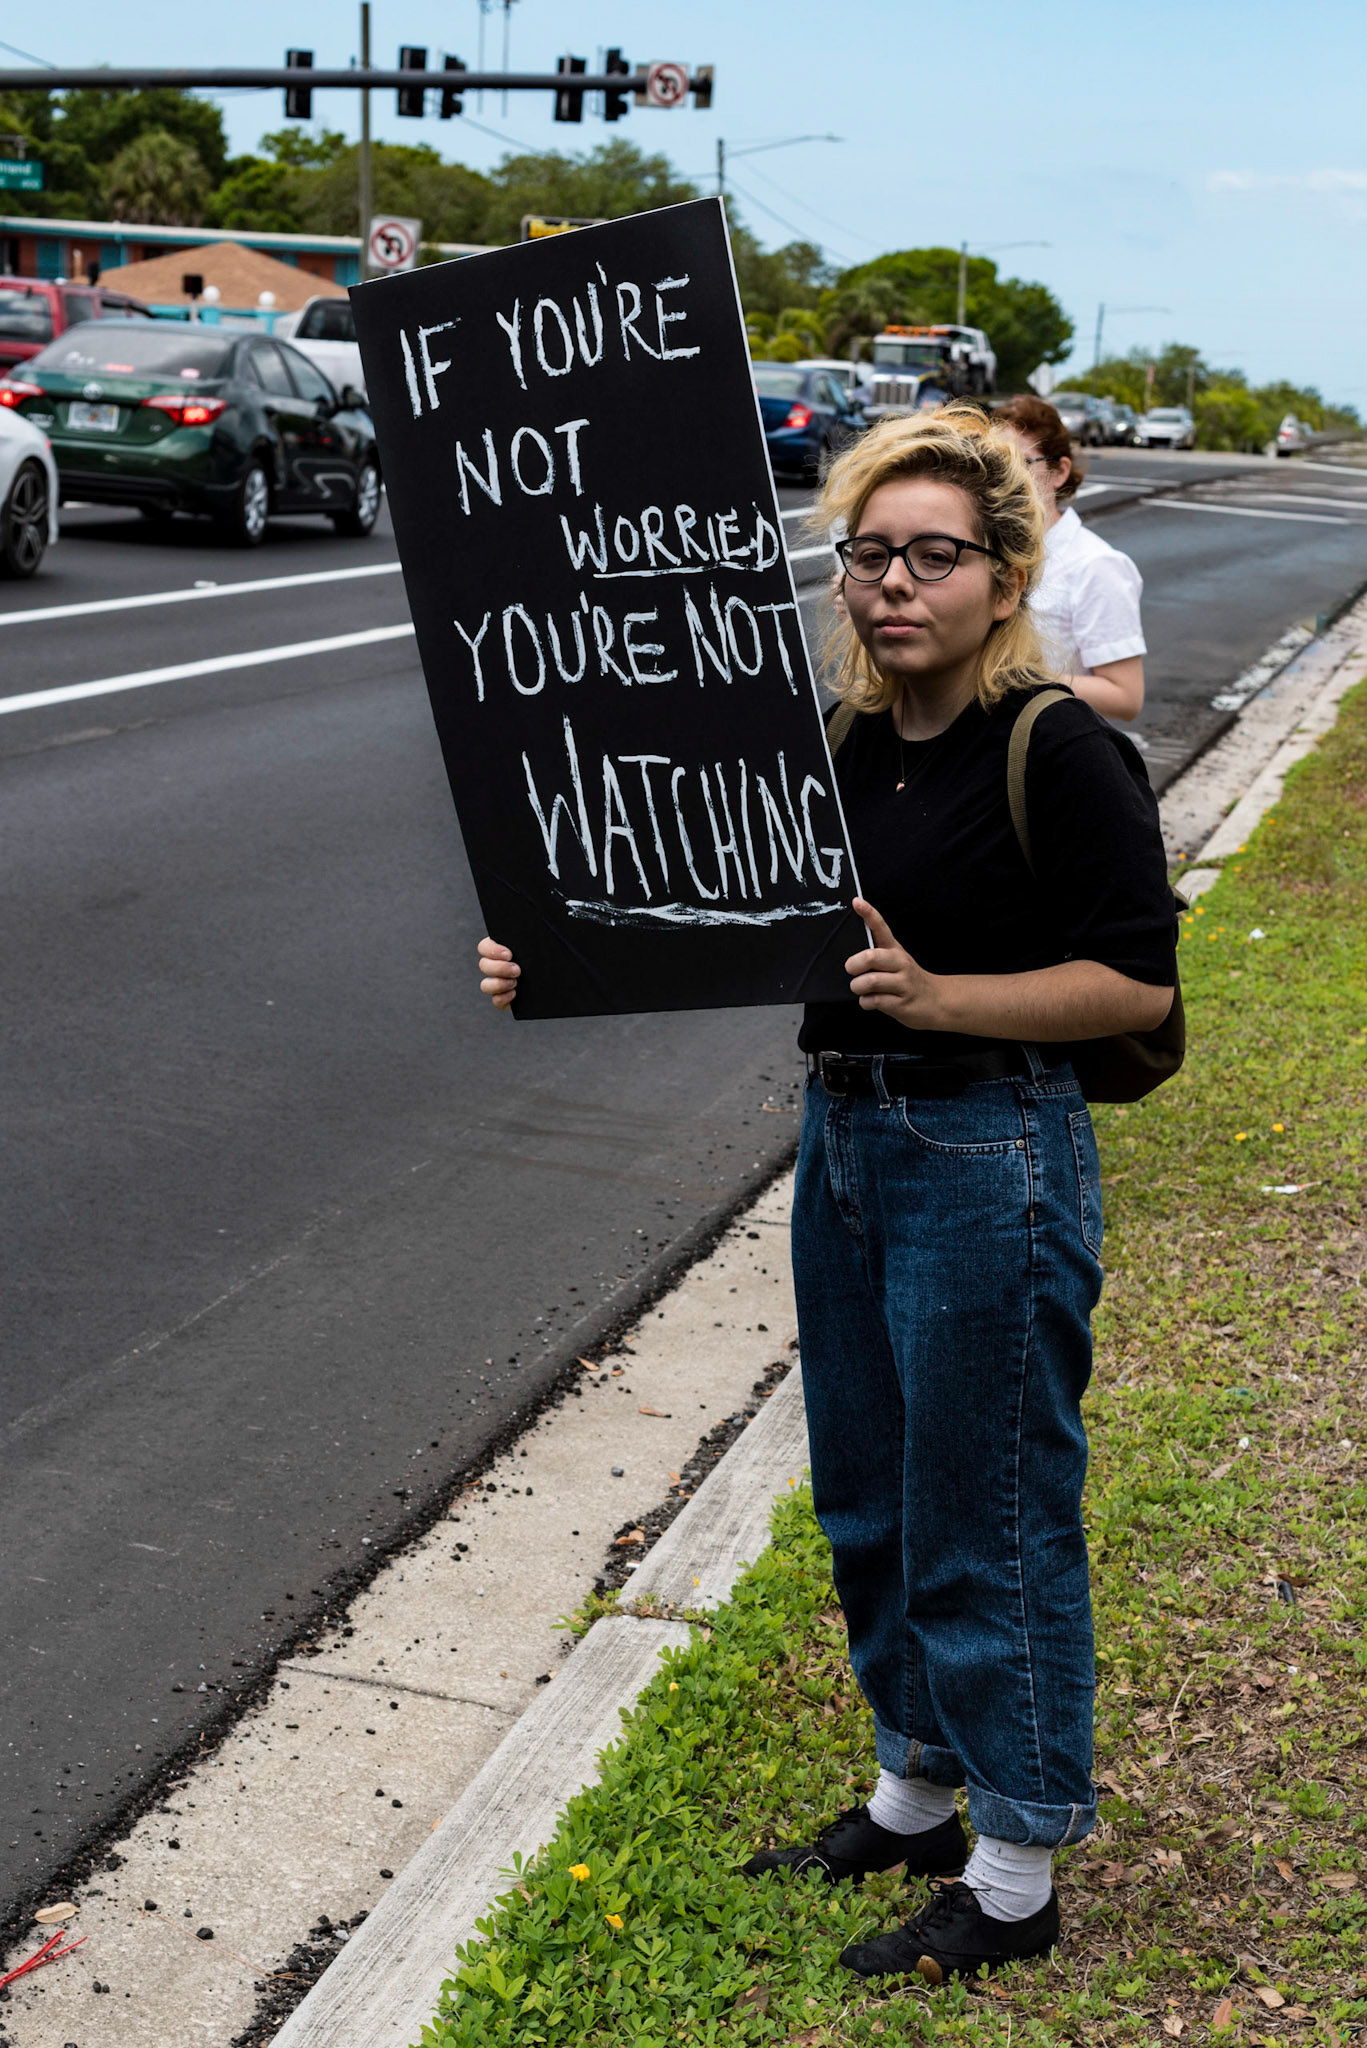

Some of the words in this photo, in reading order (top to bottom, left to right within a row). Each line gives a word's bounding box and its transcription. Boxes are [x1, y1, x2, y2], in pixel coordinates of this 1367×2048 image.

[400, 317, 461, 418] IF
[495, 261, 701, 391] YOU'RE
[455, 418, 590, 516] NOT
[560, 502, 780, 574] WORRIED
[454, 590, 678, 702] YOU'RE
[683, 581, 796, 695] NOT
[521, 712, 845, 901] WATCHING
